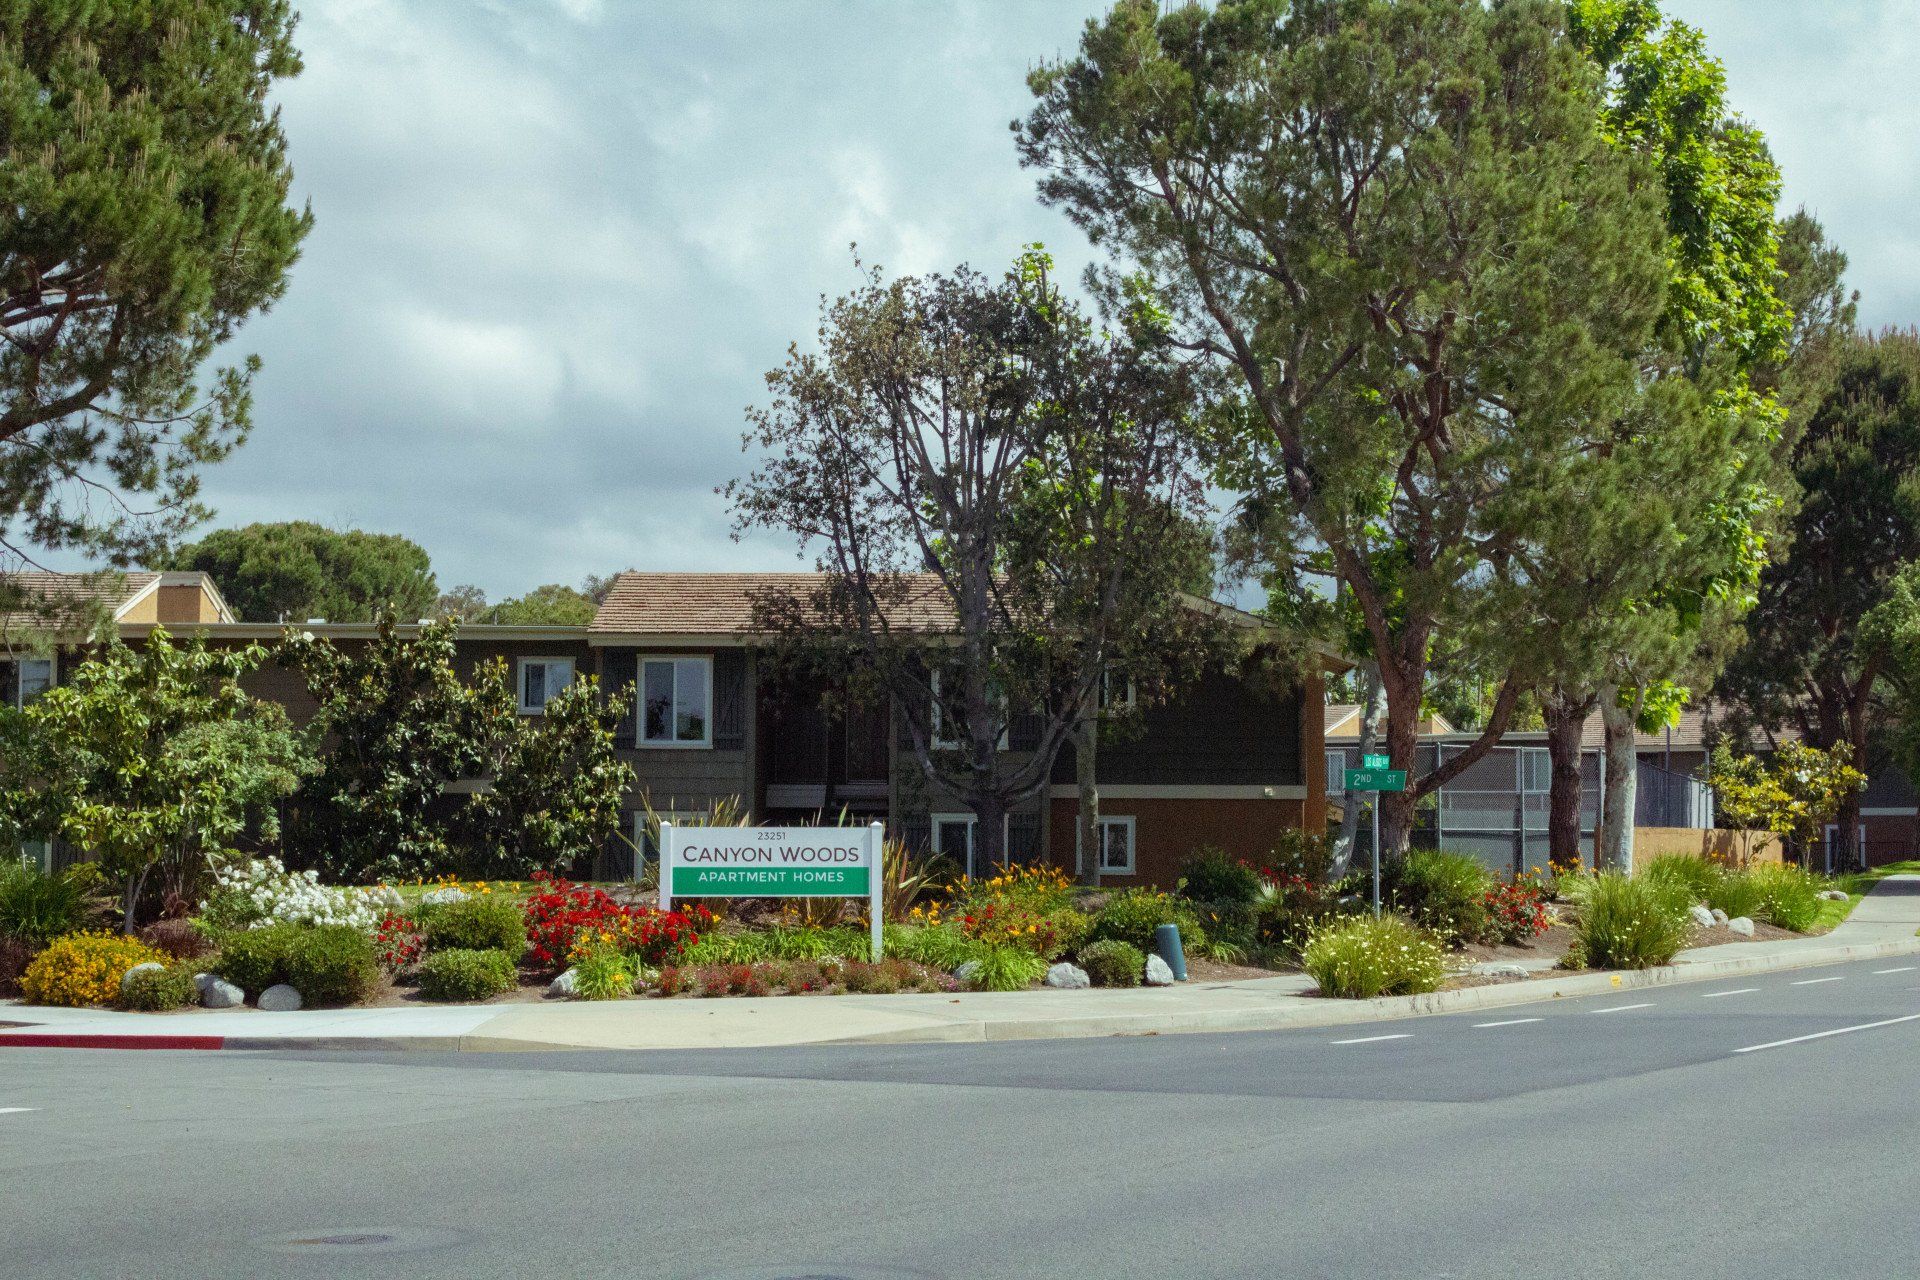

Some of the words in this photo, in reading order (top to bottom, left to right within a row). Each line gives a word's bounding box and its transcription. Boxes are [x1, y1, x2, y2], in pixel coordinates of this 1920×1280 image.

[1353, 773, 1372, 786] 2ND
[1387, 774, 1396, 784] ST
[757, 832, 786, 841] 23251
[683, 845, 772, 862] CANYON
[779, 846, 859, 862] WOODS
[698, 871, 787, 882] APARTMENT
[793, 871, 845, 882] HOMES
